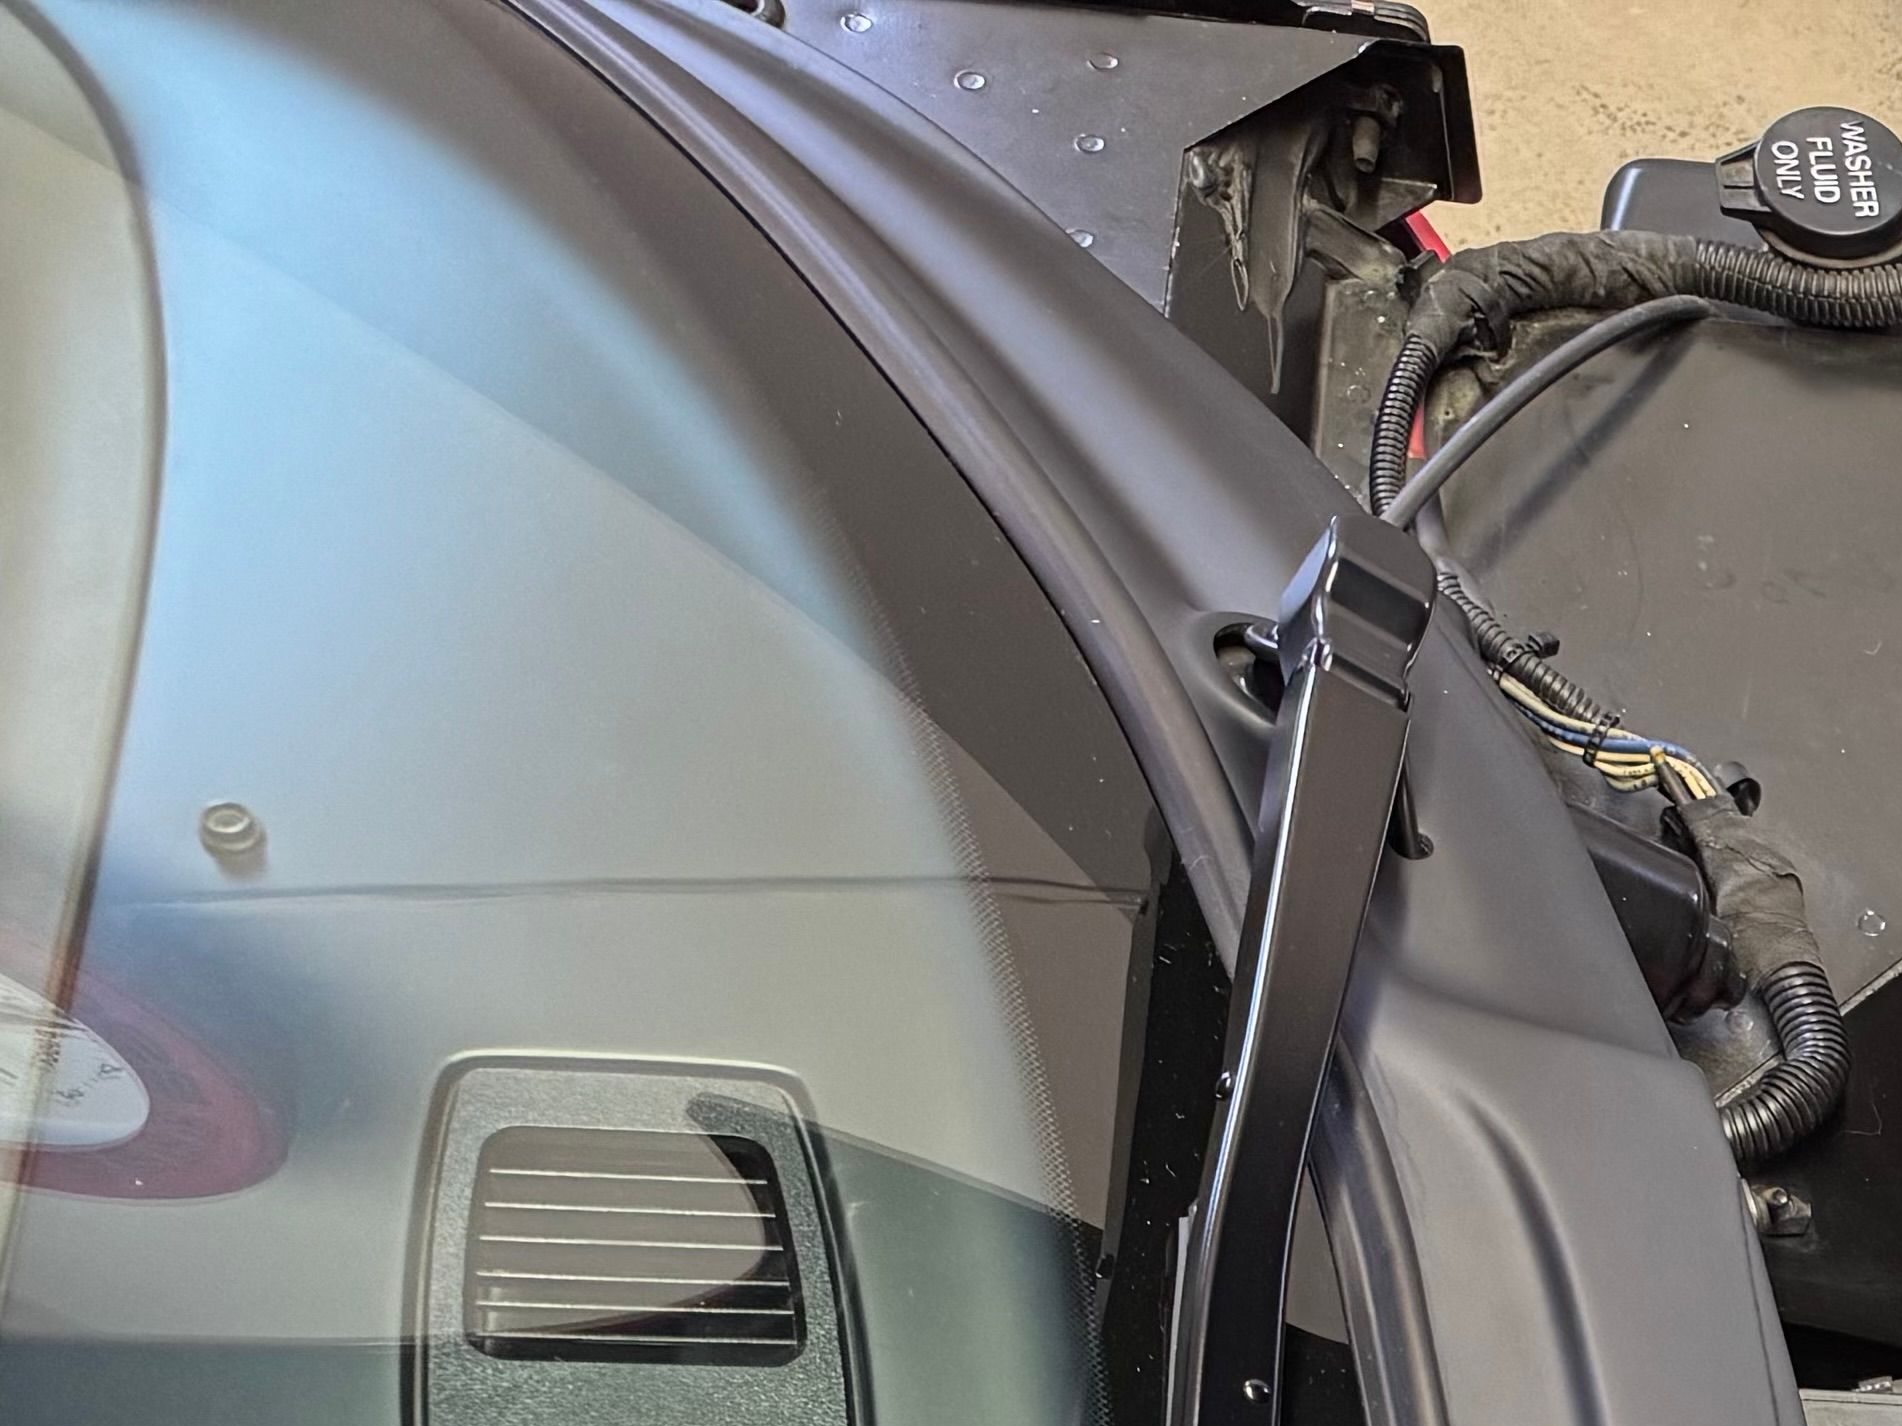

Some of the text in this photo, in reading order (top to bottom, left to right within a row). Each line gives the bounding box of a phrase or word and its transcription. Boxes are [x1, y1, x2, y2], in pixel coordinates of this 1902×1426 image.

[1771, 140, 1805, 199] ONLY
[1806, 137, 1840, 203] FLUID
[1840, 120, 1880, 217] WASHER
